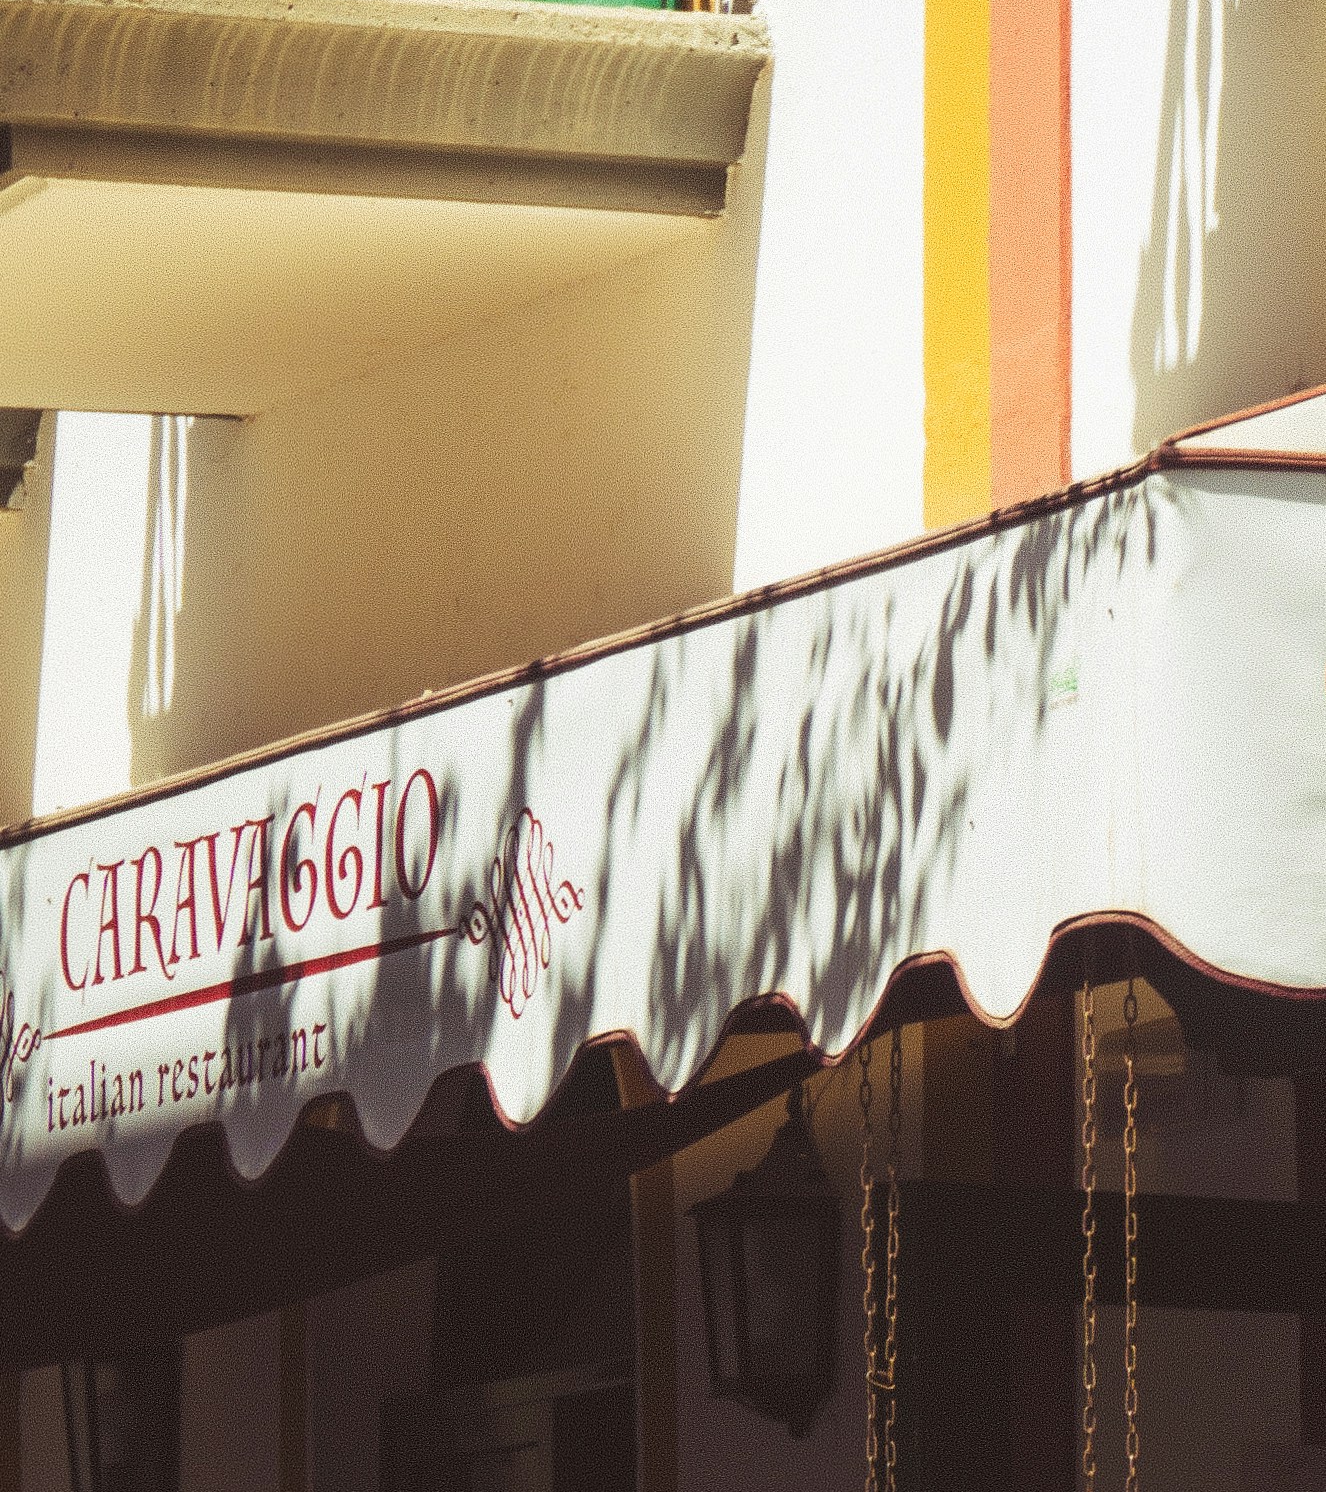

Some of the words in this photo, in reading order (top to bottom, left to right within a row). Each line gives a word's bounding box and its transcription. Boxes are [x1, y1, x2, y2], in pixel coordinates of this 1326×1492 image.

[59, 768, 438, 1000] CARAVAGGIO
[48, 1058, 145, 1133] italian
[158, 1023, 327, 1106] restaurant
